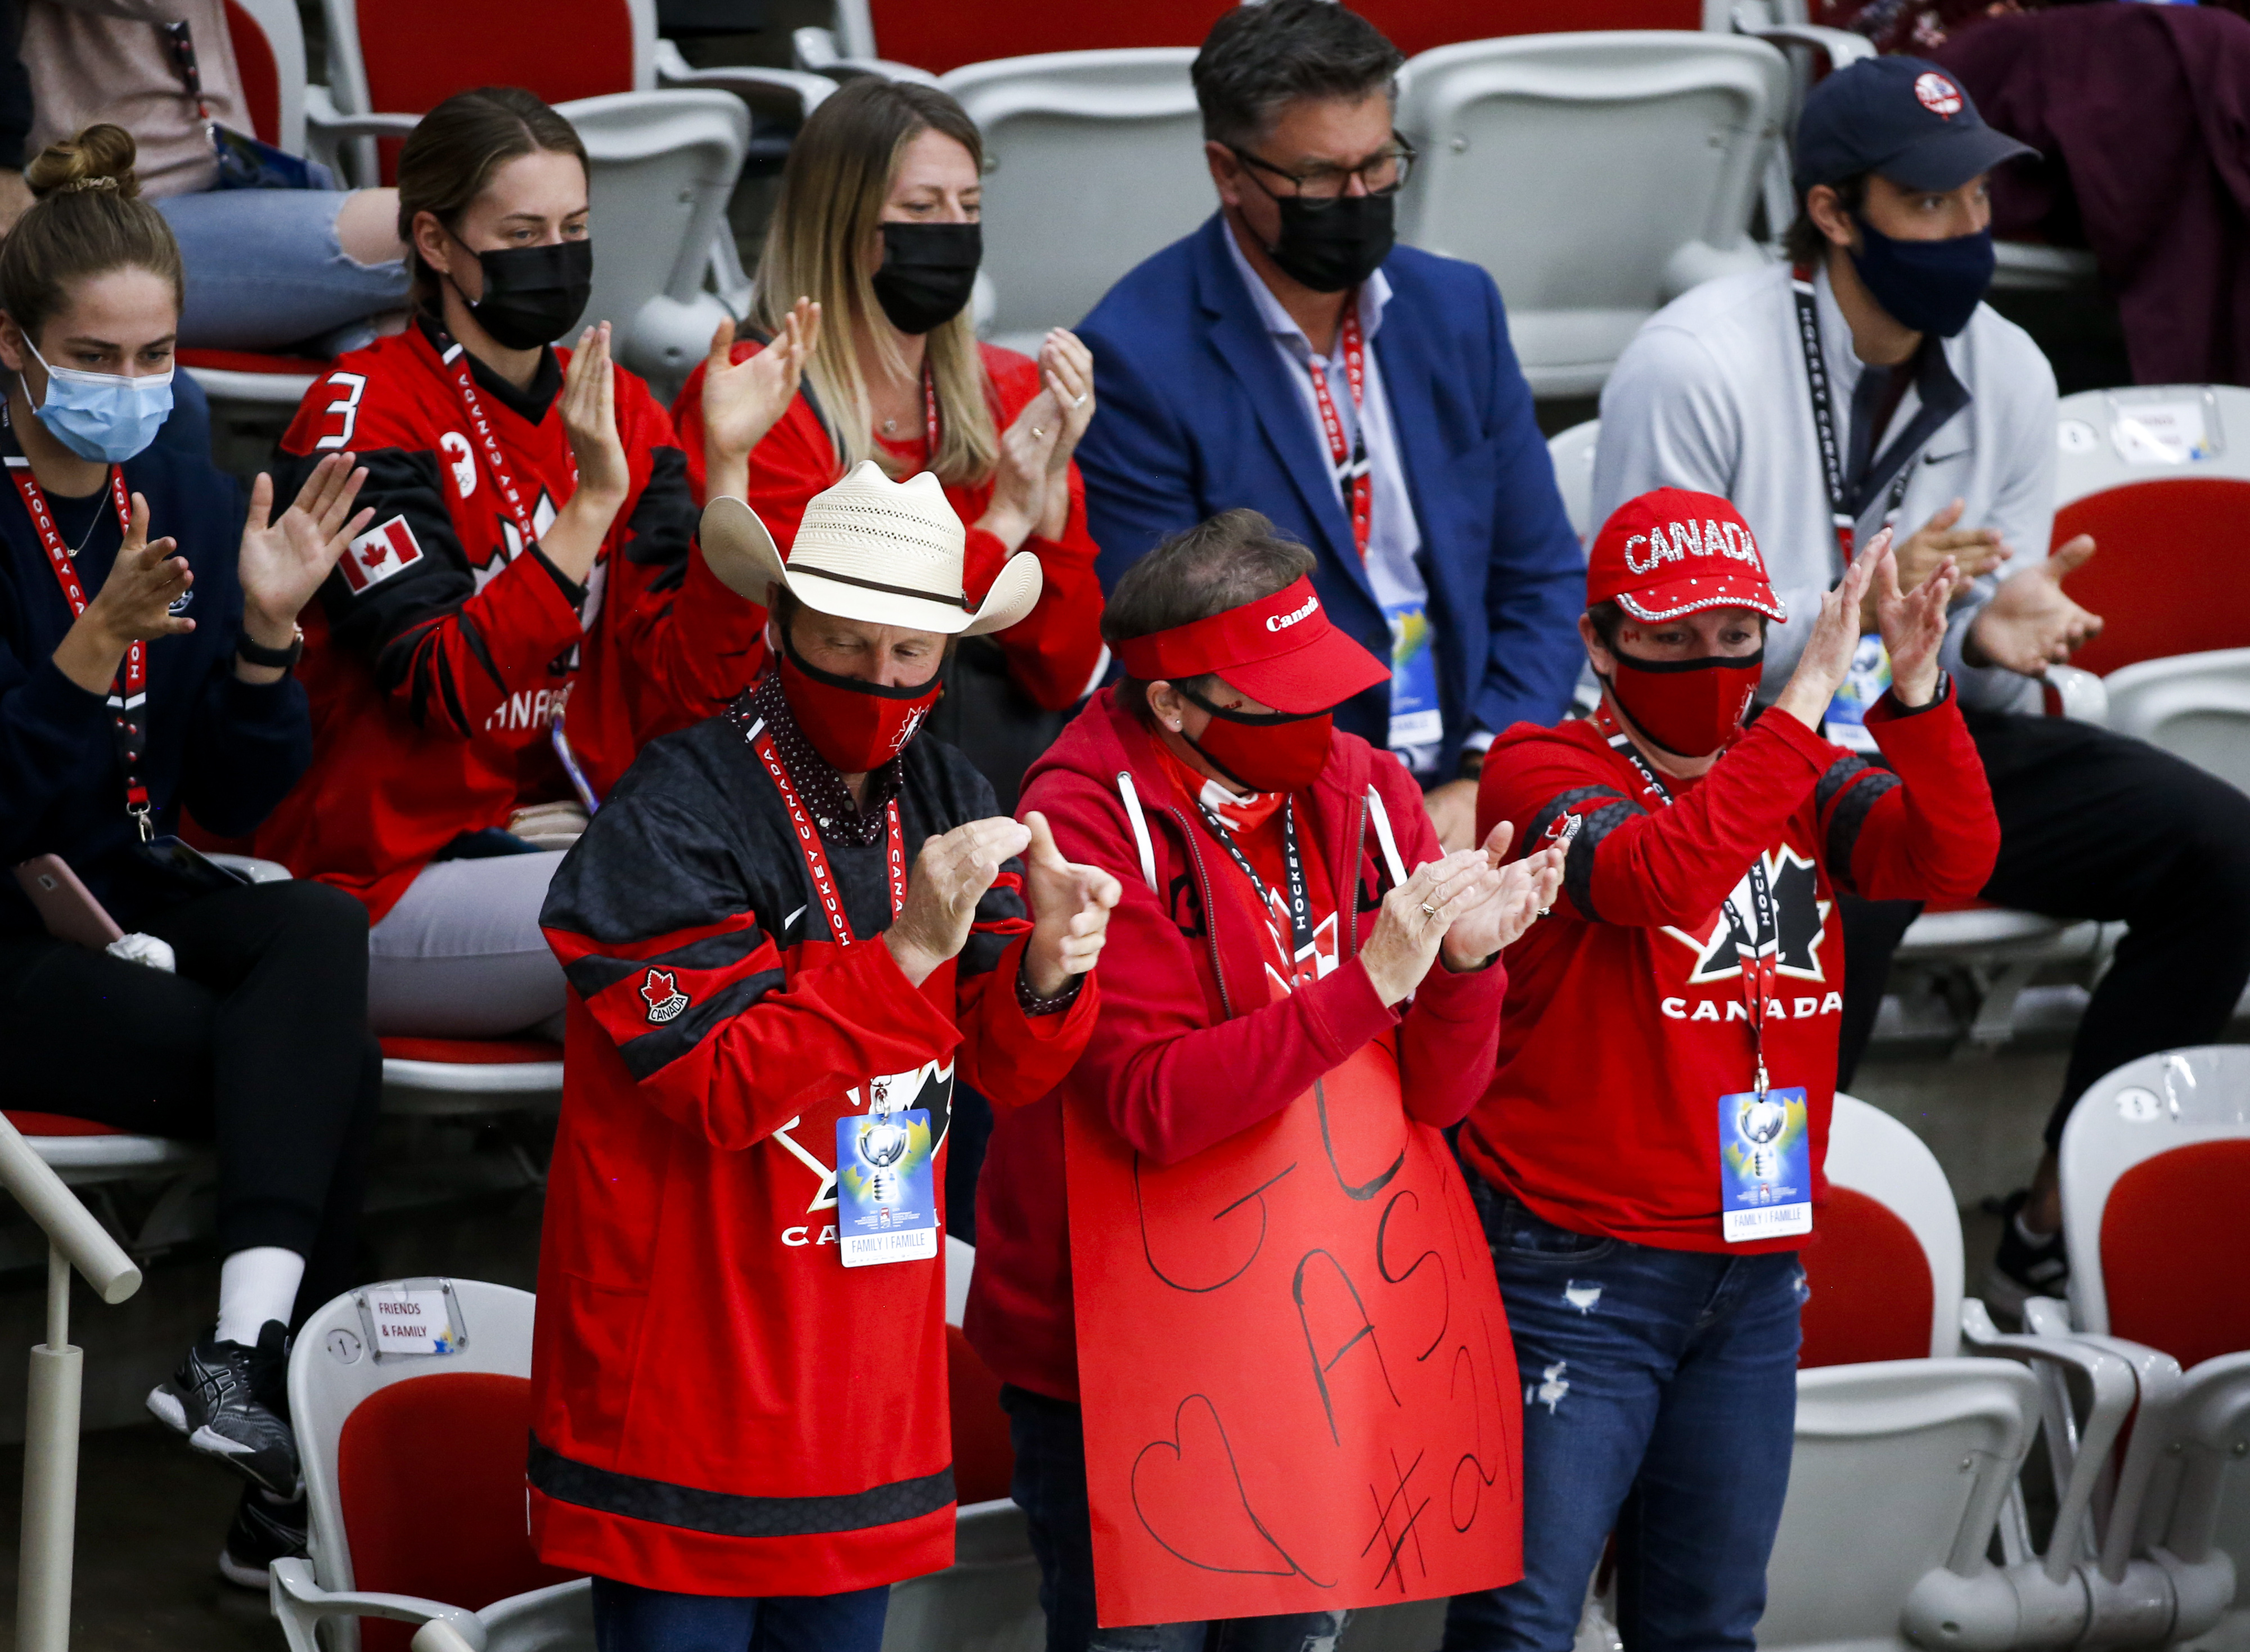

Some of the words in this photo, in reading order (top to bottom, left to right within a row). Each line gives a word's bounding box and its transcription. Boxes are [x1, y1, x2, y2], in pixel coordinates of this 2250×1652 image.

[316, 372, 367, 449] 3
[458, 373, 503, 465] CANADA
[25, 481, 71, 575] HOCKEY
[1624, 519, 1762, 574] CANADA
[763, 748, 811, 840] CANADA
[807, 849, 850, 946] HOCKEY
[891, 848, 903, 913] CANA
[1288, 842, 1307, 930] HOCKEY
[1752, 865, 1771, 926] HOCK
[651, 997, 686, 1020] CANADA
[852, 1237, 883, 1254] FAMILY
[891, 1232, 925, 1250] FAMILLE
[1734, 1212, 1762, 1227] FAMILY
[1770, 1207, 1801, 1223] FAMILLE
[379, 1303, 421, 1315] FRIENDS
[382, 1324, 389, 1336] &
[392, 1324, 427, 1337] FAMILY
